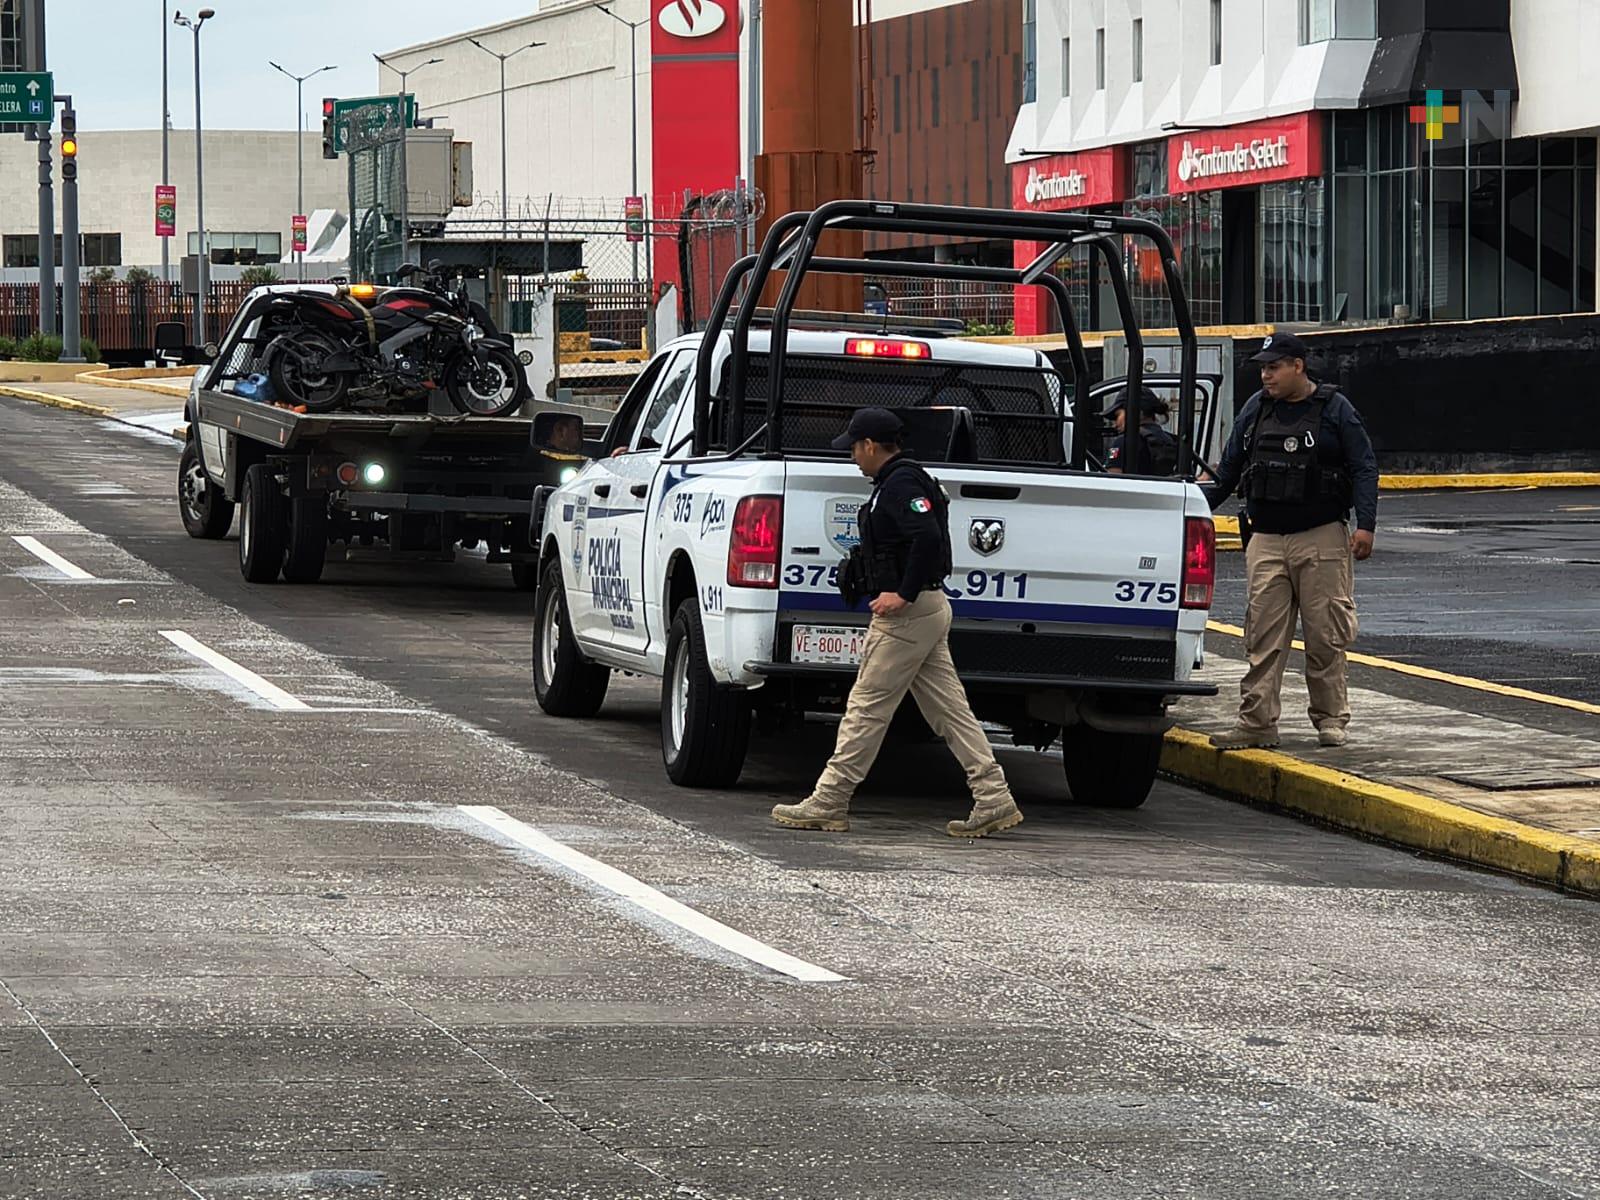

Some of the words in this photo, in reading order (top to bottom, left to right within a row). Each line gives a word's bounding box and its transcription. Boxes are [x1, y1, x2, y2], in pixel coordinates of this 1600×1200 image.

[1193, 144, 1249, 178] Santander
[1250, 135, 1289, 169] Select
[1036, 168, 1087, 201] Santander
[673, 493, 693, 522] 375
[588, 527, 622, 577] POLICÍA
[784, 564, 840, 587] 375
[966, 570, 1028, 599] 911
[708, 585, 723, 611] 911
[1115, 581, 1177, 604] 375
